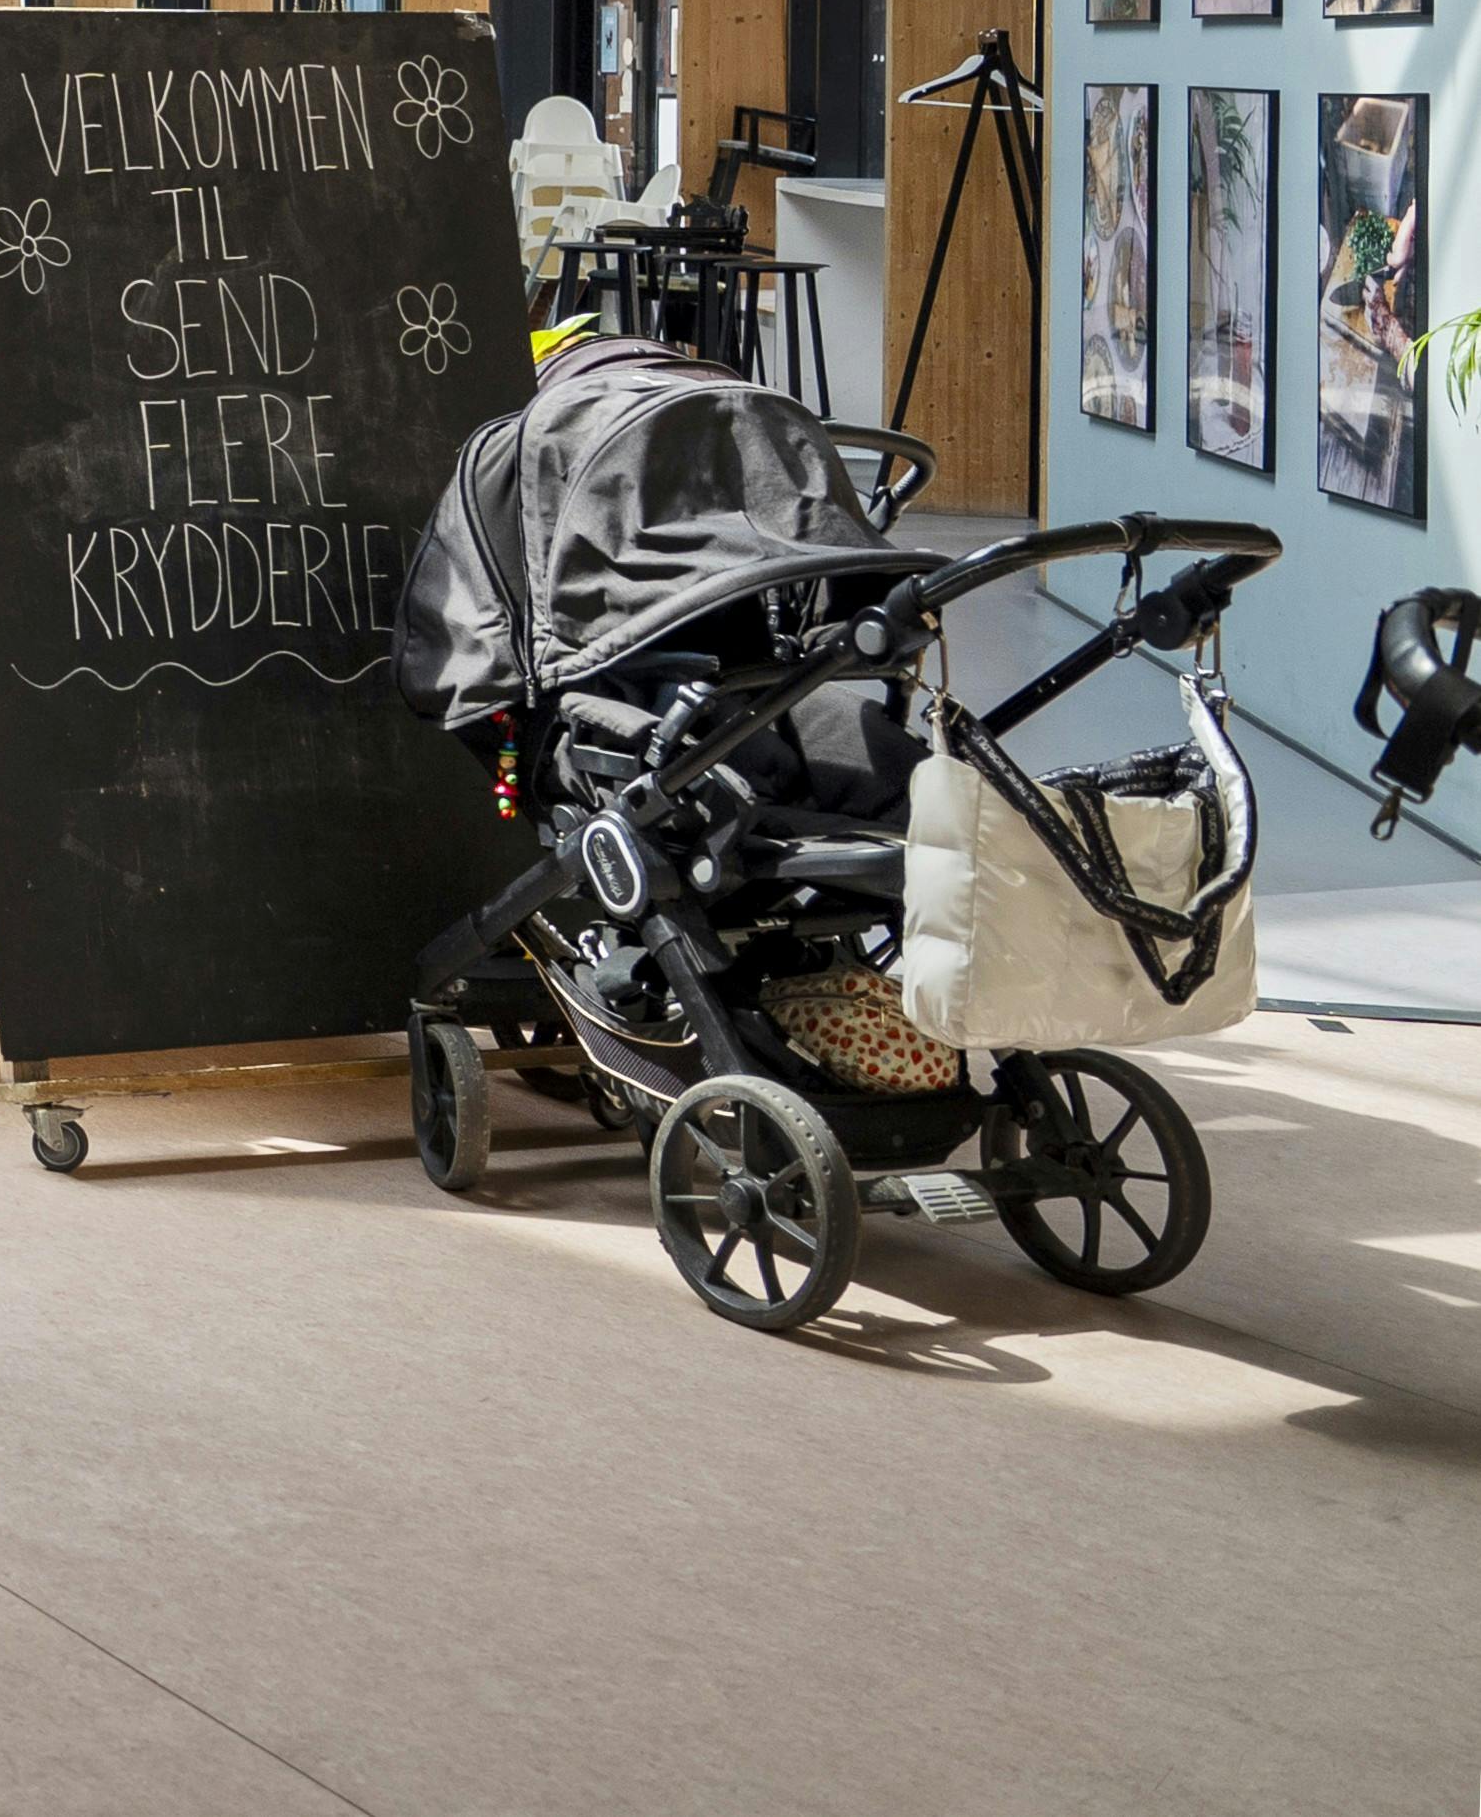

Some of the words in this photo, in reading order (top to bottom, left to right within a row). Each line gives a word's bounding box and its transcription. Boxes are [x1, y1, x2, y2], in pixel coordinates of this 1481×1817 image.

[19, 61, 375, 177] VELKOMMEN
[150, 185, 249, 263] TIL
[121, 274, 318, 380] SEND
[139, 394, 348, 510] FLERE
